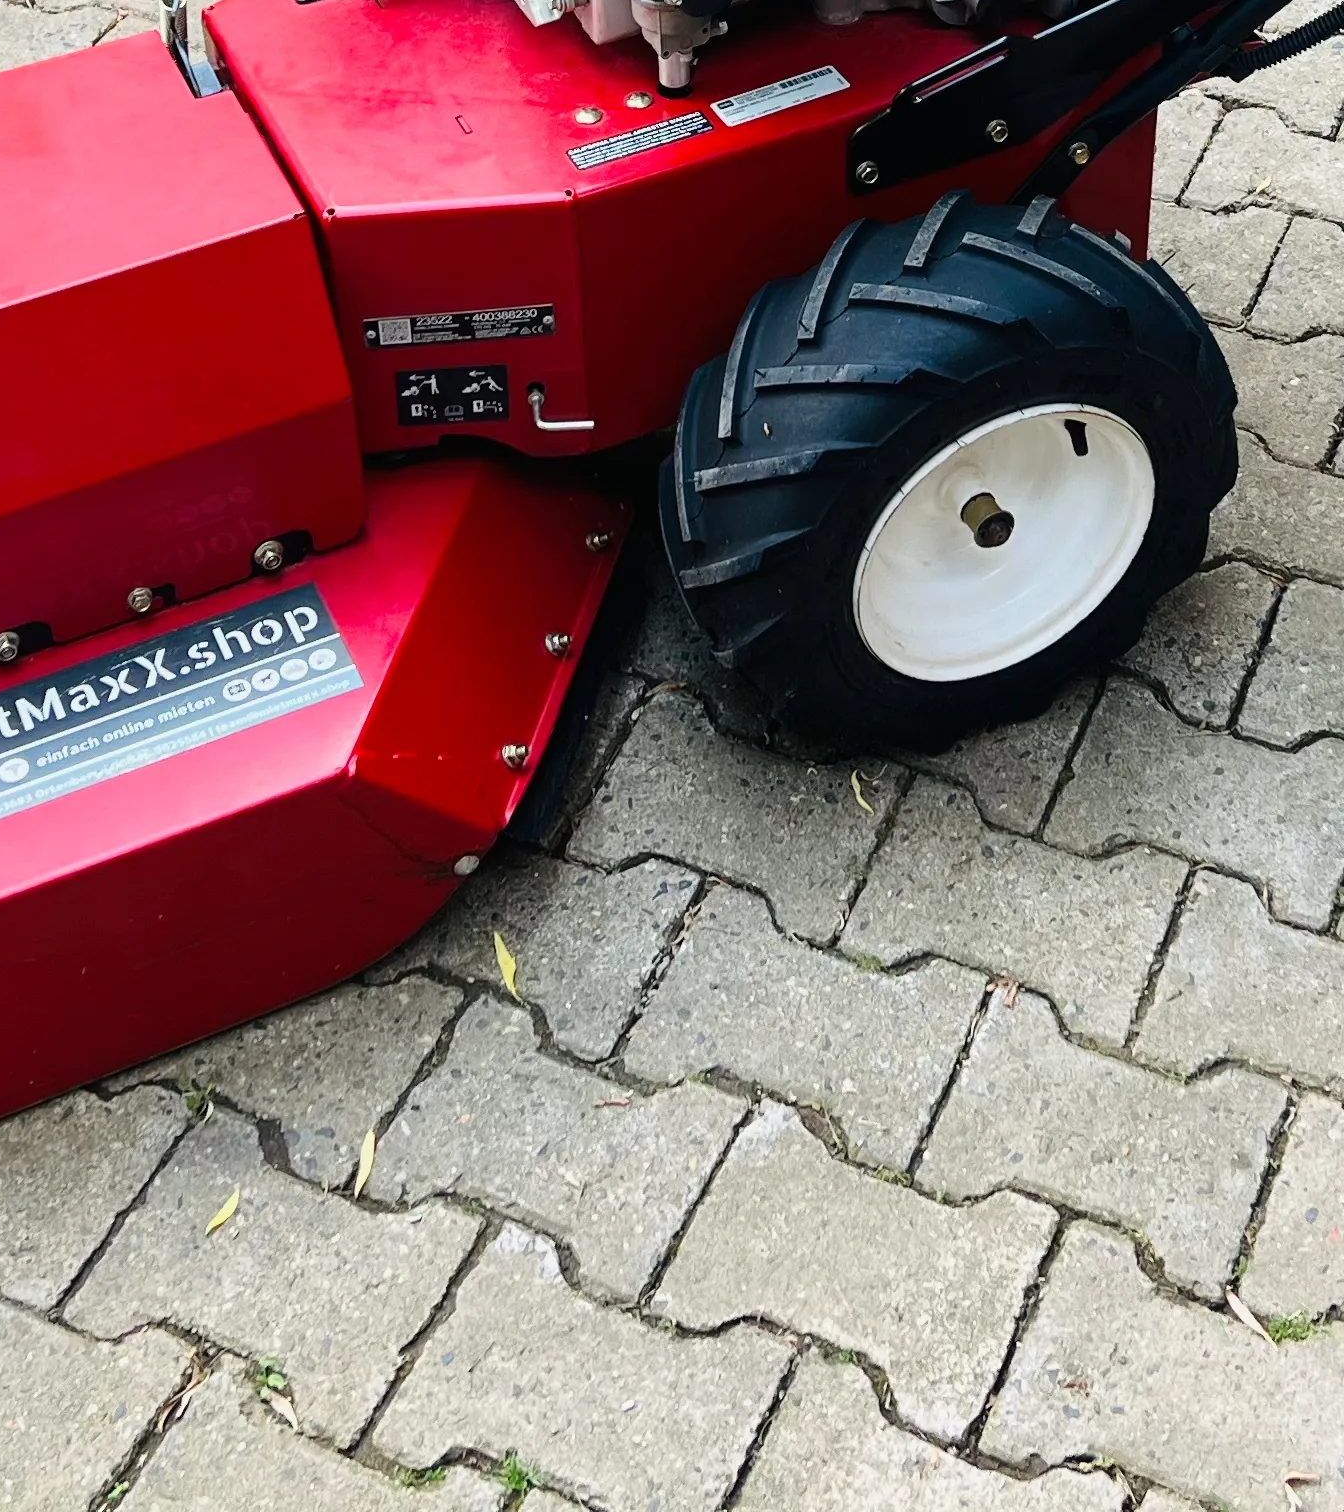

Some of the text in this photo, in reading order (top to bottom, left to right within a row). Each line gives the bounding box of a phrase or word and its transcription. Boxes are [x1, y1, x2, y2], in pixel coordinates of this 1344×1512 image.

[416, 315, 453, 326] 23522
[36, 695, 216, 768] einfach online mieten
